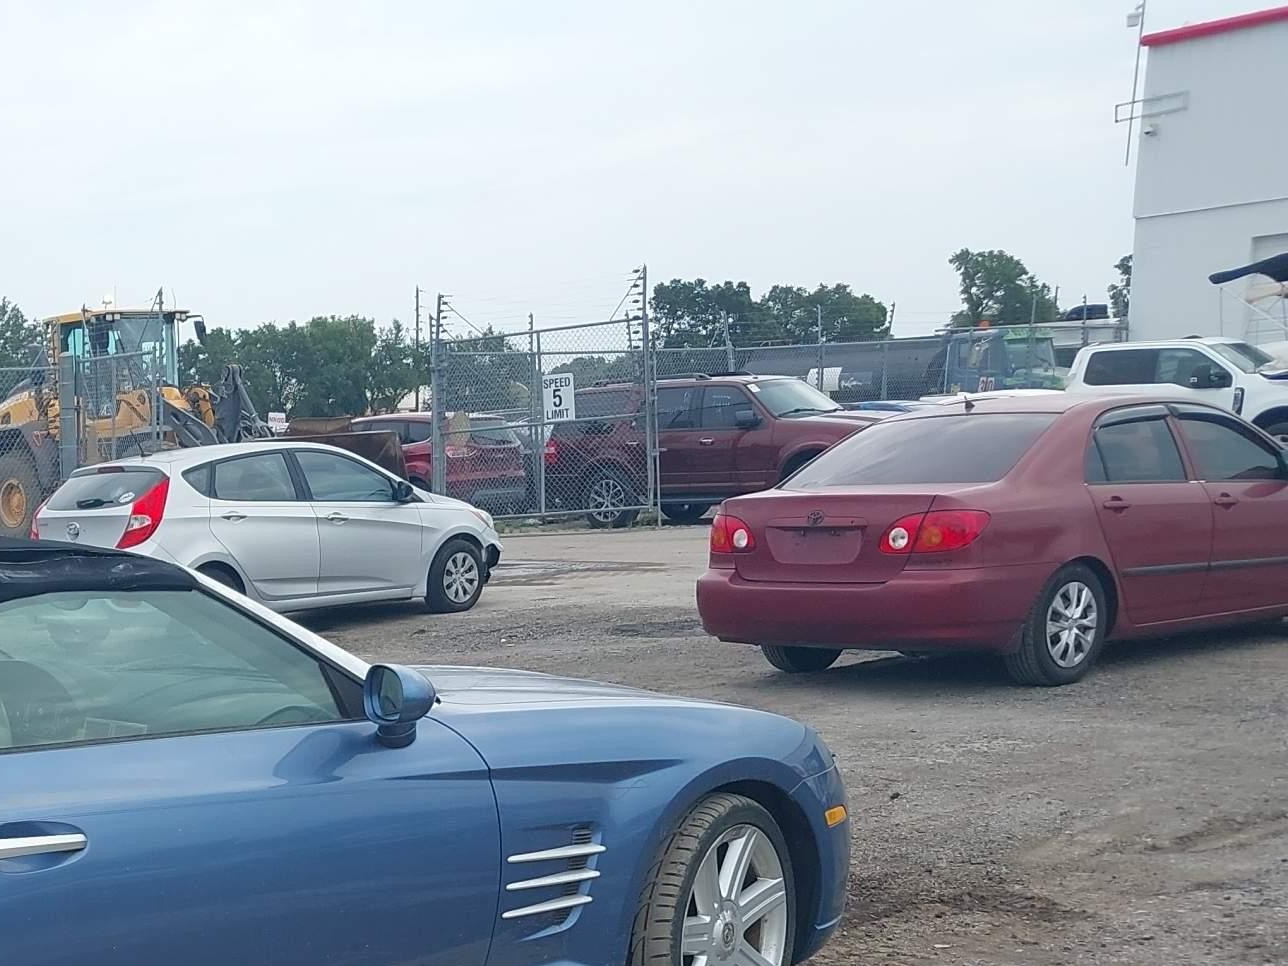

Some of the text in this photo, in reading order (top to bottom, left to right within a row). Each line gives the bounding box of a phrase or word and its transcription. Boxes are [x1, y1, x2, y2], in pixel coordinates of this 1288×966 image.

[543, 377, 571, 390] SPEED
[553, 388, 563, 408] 5
[546, 408, 570, 420] LIMIT
